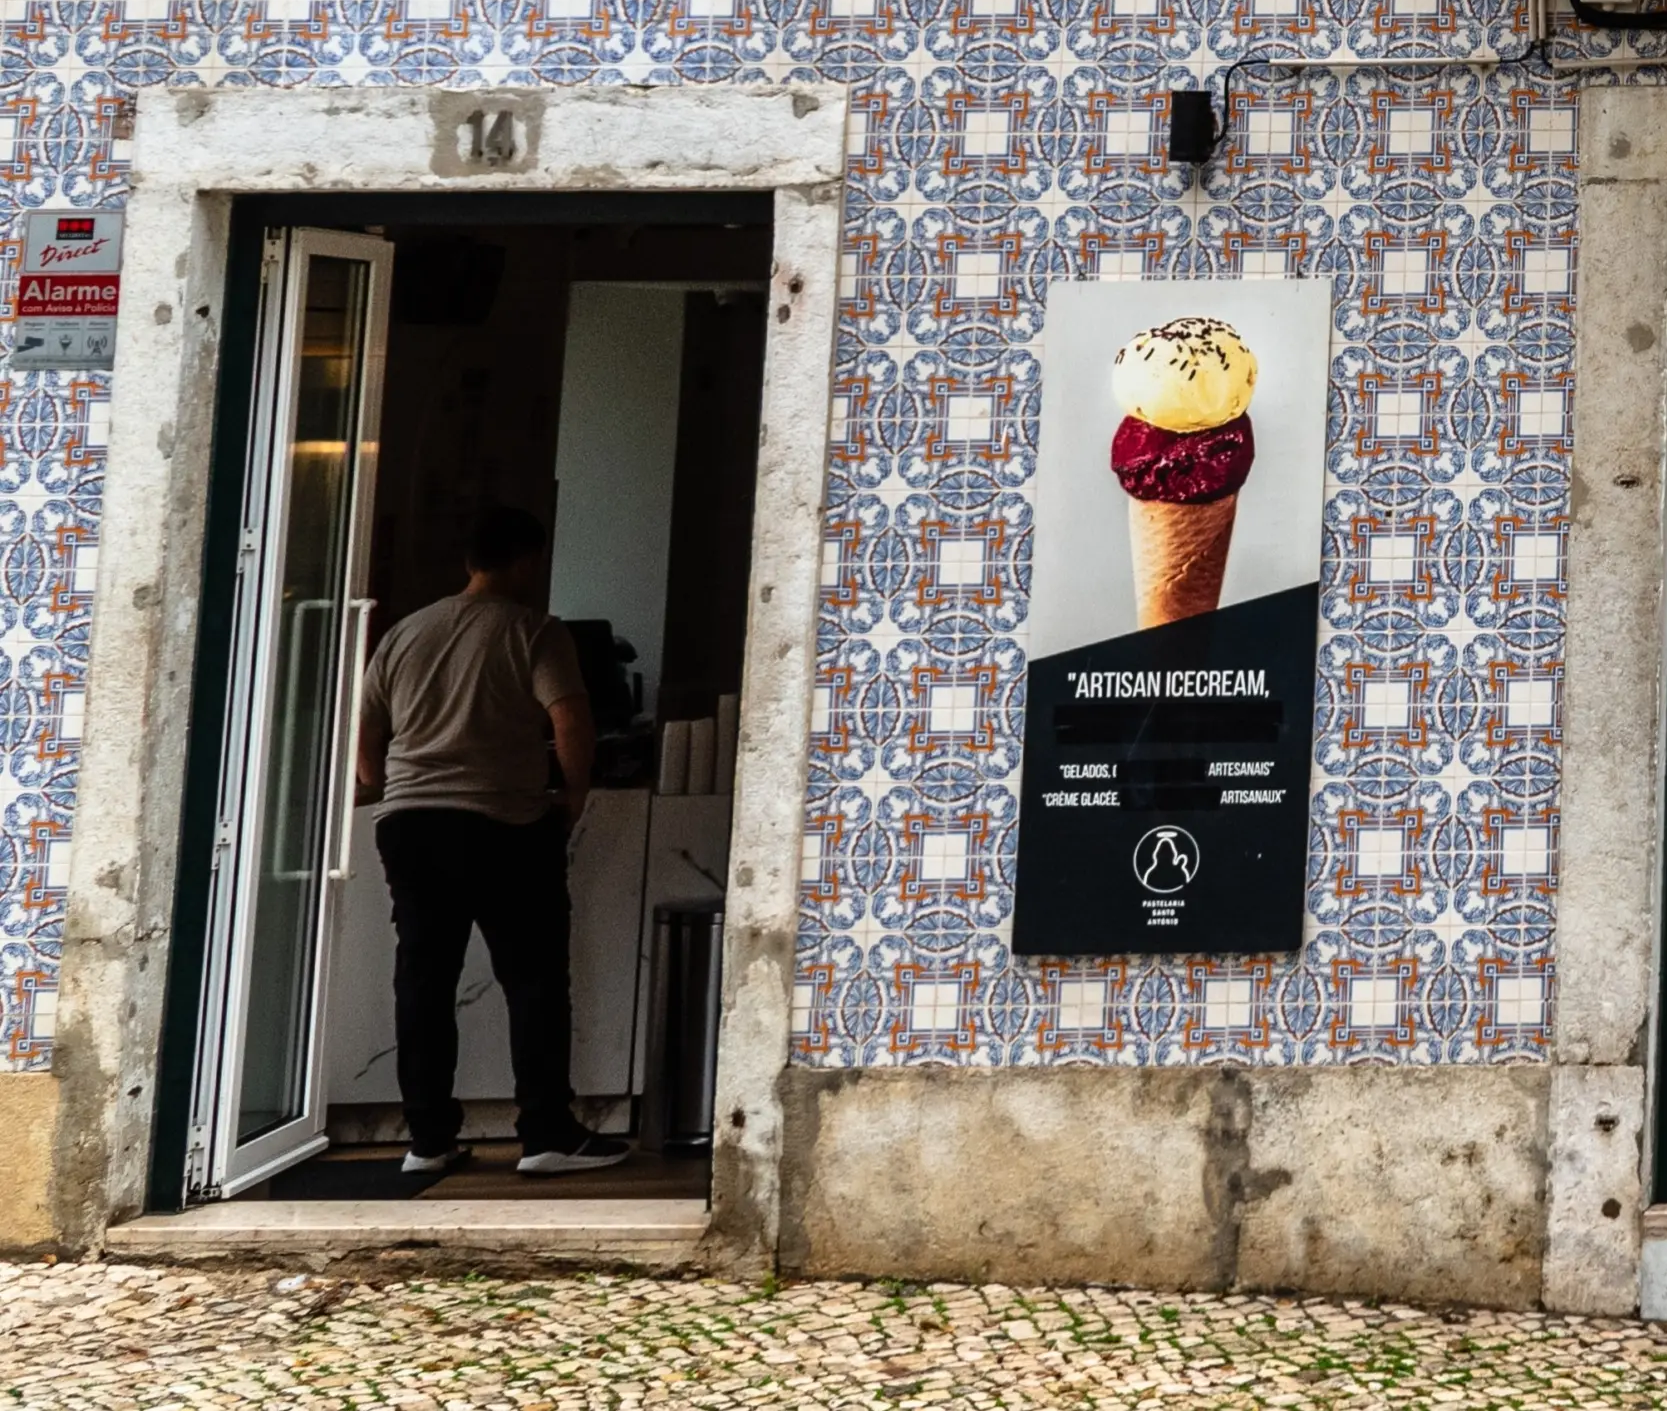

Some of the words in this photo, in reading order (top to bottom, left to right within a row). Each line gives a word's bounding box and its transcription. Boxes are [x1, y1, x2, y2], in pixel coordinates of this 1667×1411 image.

[466, 110, 516, 161] 14
[39, 238, 110, 267] Direct
[23, 279, 116, 301] Alarme
[45, 304, 73, 312] Aviso
[1165, 670, 1270, 698] ICECREAM,
